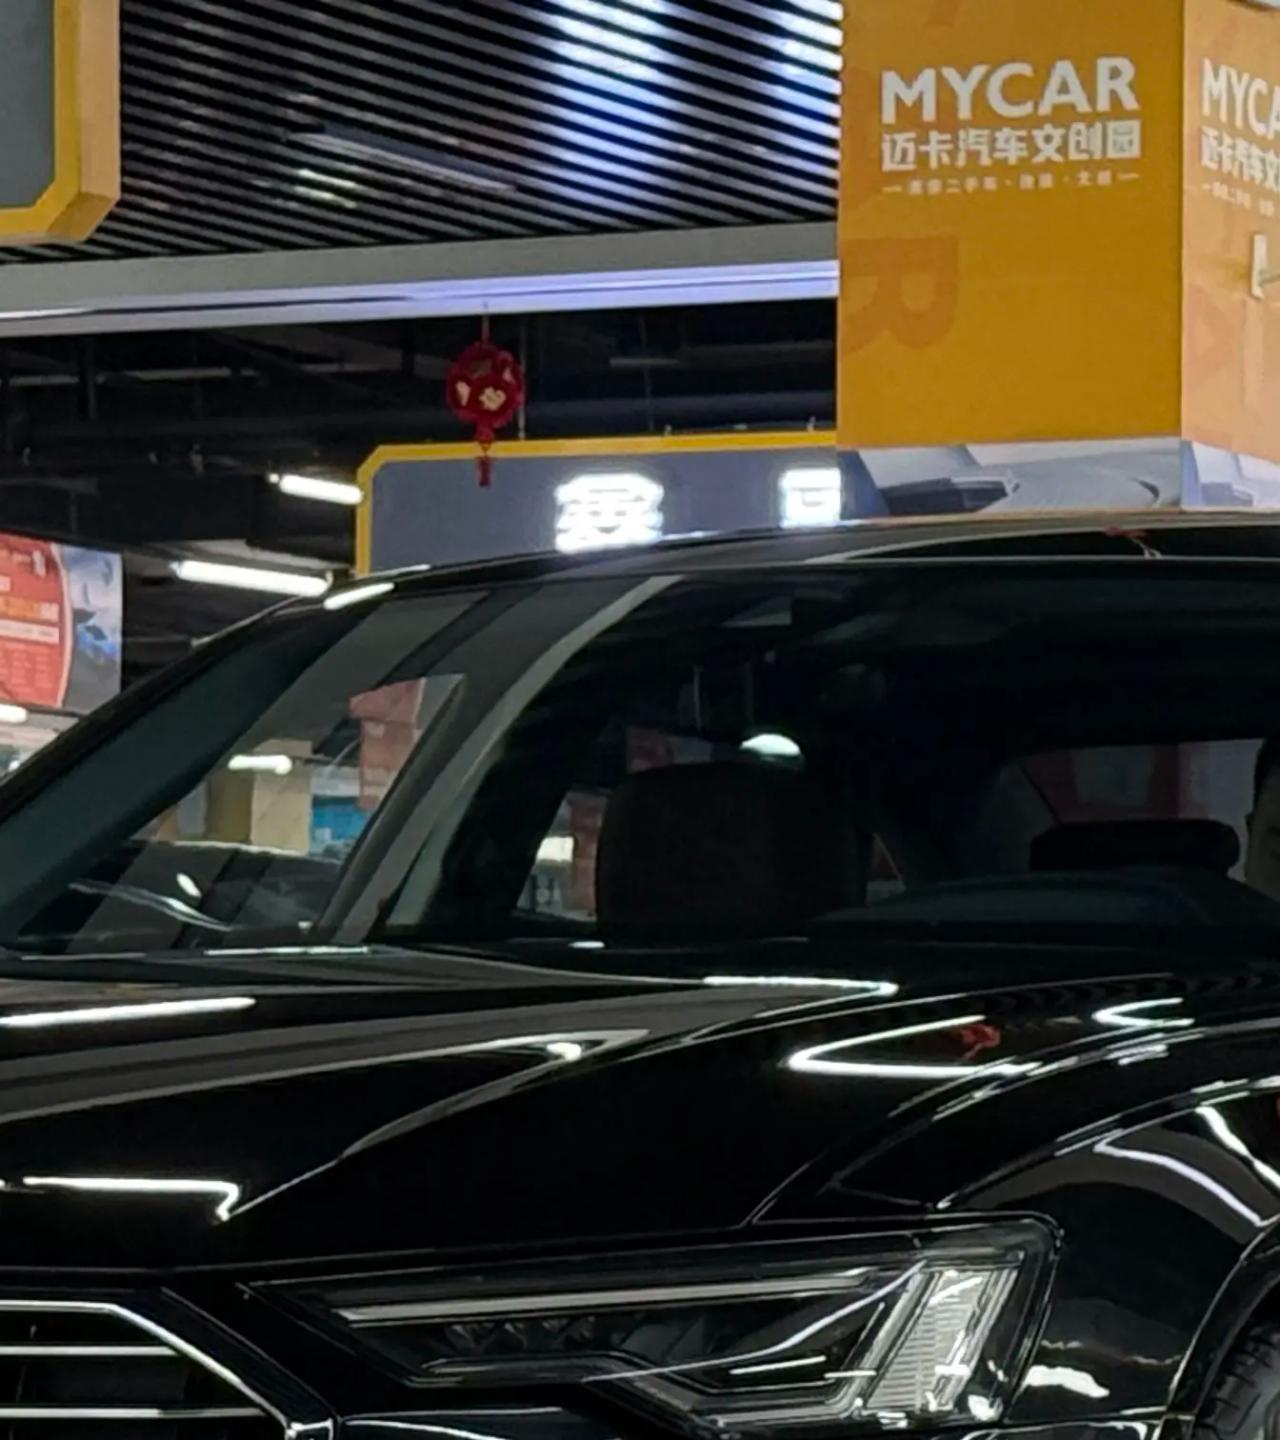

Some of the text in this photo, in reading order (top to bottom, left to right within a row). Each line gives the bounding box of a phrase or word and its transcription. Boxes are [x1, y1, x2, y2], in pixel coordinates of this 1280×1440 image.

[880, 56, 1141, 126] MYCAR
[881, 119, 1141, 173] 迈卡汽车文创园
